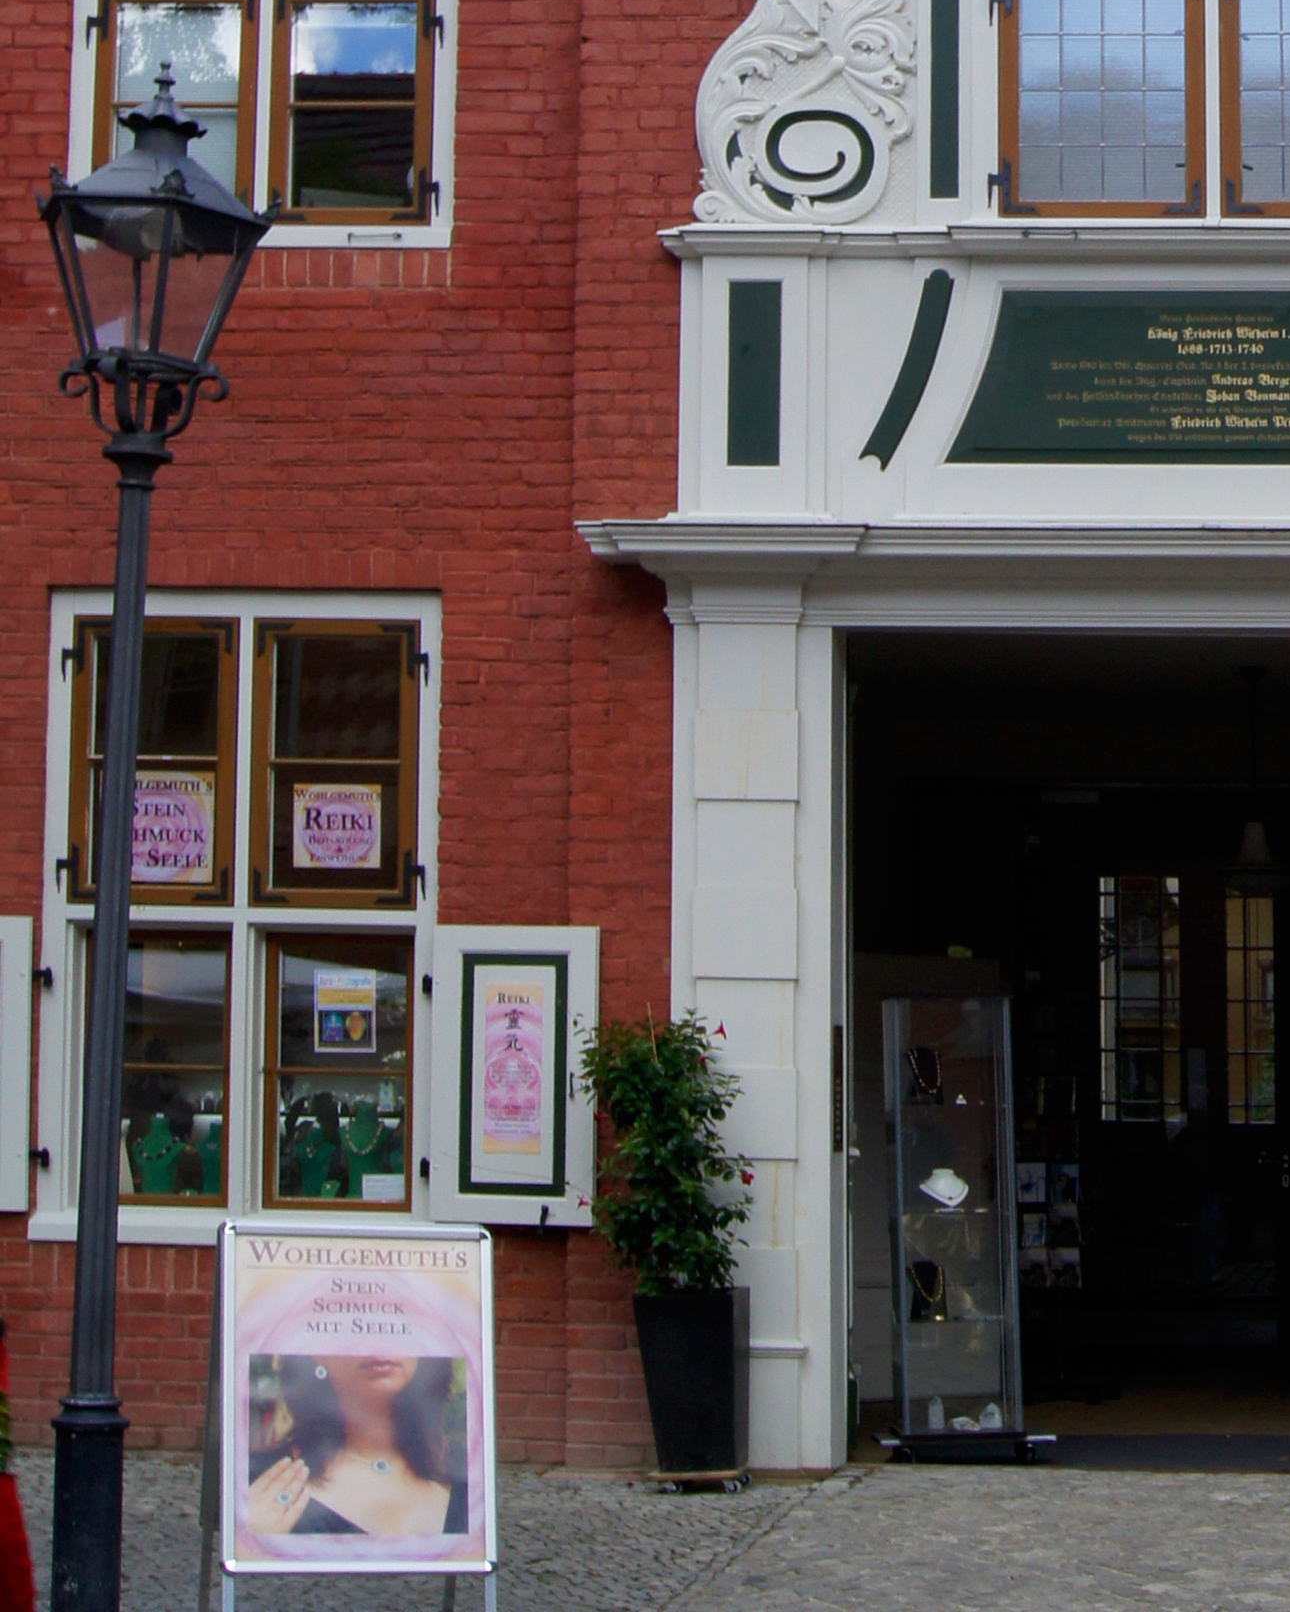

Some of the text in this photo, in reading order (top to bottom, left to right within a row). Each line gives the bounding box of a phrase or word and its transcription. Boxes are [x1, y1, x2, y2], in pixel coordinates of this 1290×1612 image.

[1147, 326, 1178, 342] König
[1182, 326, 1233, 341] Friedrich
[1236, 326, 1279, 340] Wilhelm
[1211, 373, 1253, 385] Andreas
[1171, 415, 1221, 429] Friedrich
[1225, 415, 1268, 428] Wilhelm
[304, 807, 373, 830] REIKI
[134, 828, 206, 843] HMUCK
[146, 848, 208, 868] SEELE
[497, 992, 529, 1004] REIKI
[247, 1239, 467, 1268] WOHLGEMUTH'S
[331, 1277, 386, 1294] STEIN
[313, 1297, 404, 1314] SCHMUCK
[307, 1318, 412, 1335] MIT SEELE
